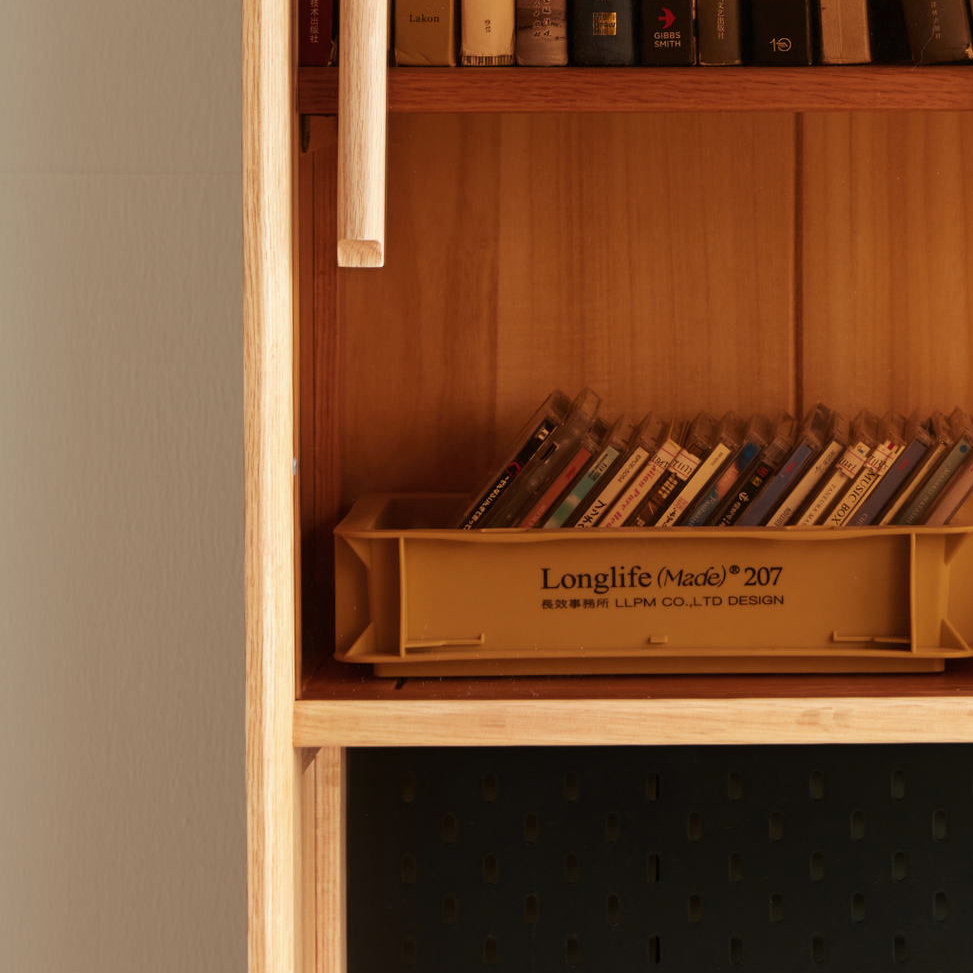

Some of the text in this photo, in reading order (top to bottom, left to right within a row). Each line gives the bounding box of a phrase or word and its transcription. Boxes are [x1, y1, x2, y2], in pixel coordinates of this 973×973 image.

[409, 14, 440, 23] Lakon
[654, 32, 681, 40] GIBBS
[654, 40, 681, 48] SMITH
[618, 454, 642, 483] EPCE-5054
[847, 467, 876, 503] MUSIC
[928, 467, 951, 496] MASAKO
[621, 487, 641, 511] Pure
[812, 483, 837, 513] TANEURA
[905, 495, 930, 525] HAYASHI
[774, 507, 792, 527] EDITION
[831, 502, 851, 526] BOX
[541, 565, 652, 595] Longlife
[744, 567, 783, 587] 207
[541, 595, 785, 610] 長效事務所 LLPM CO.,LTD DESIGN
